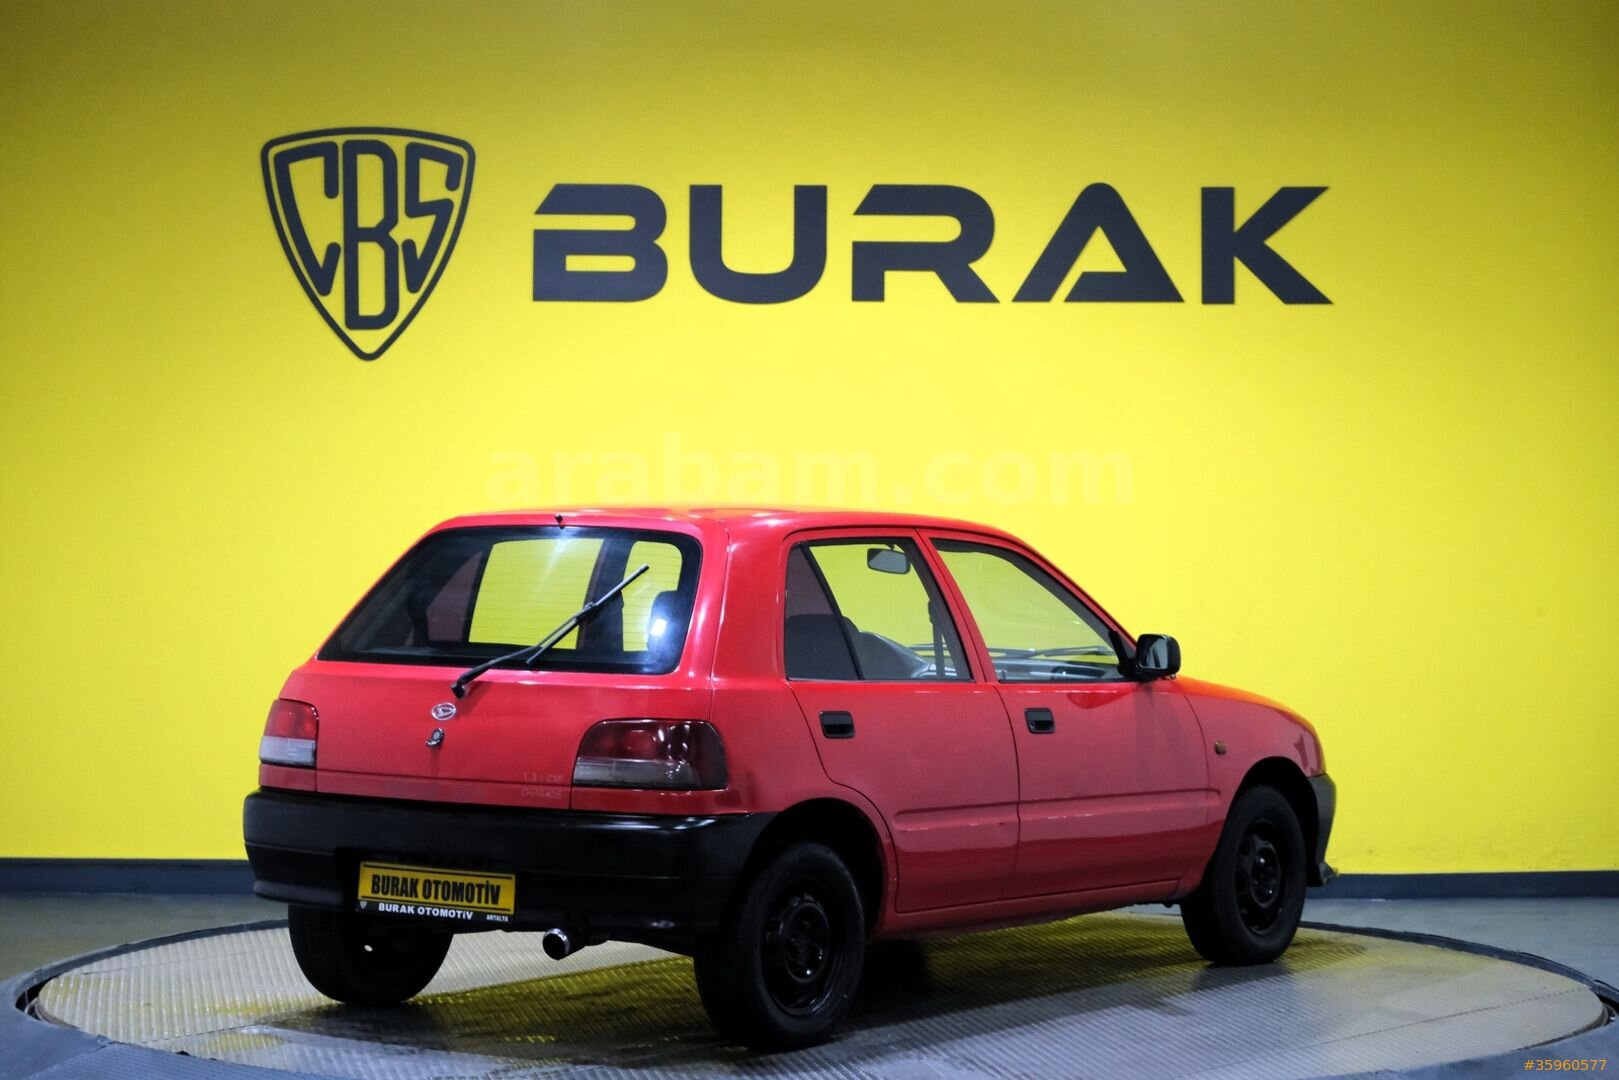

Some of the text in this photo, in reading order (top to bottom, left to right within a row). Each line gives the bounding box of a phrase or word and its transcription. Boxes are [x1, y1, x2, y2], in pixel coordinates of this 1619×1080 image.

[274, 139, 464, 330] CBS
[533, 182, 1334, 305] BURAK
[371, 874, 501, 905] BURAK OTOMOTİV
[378, 902, 415, 915] BURAK
